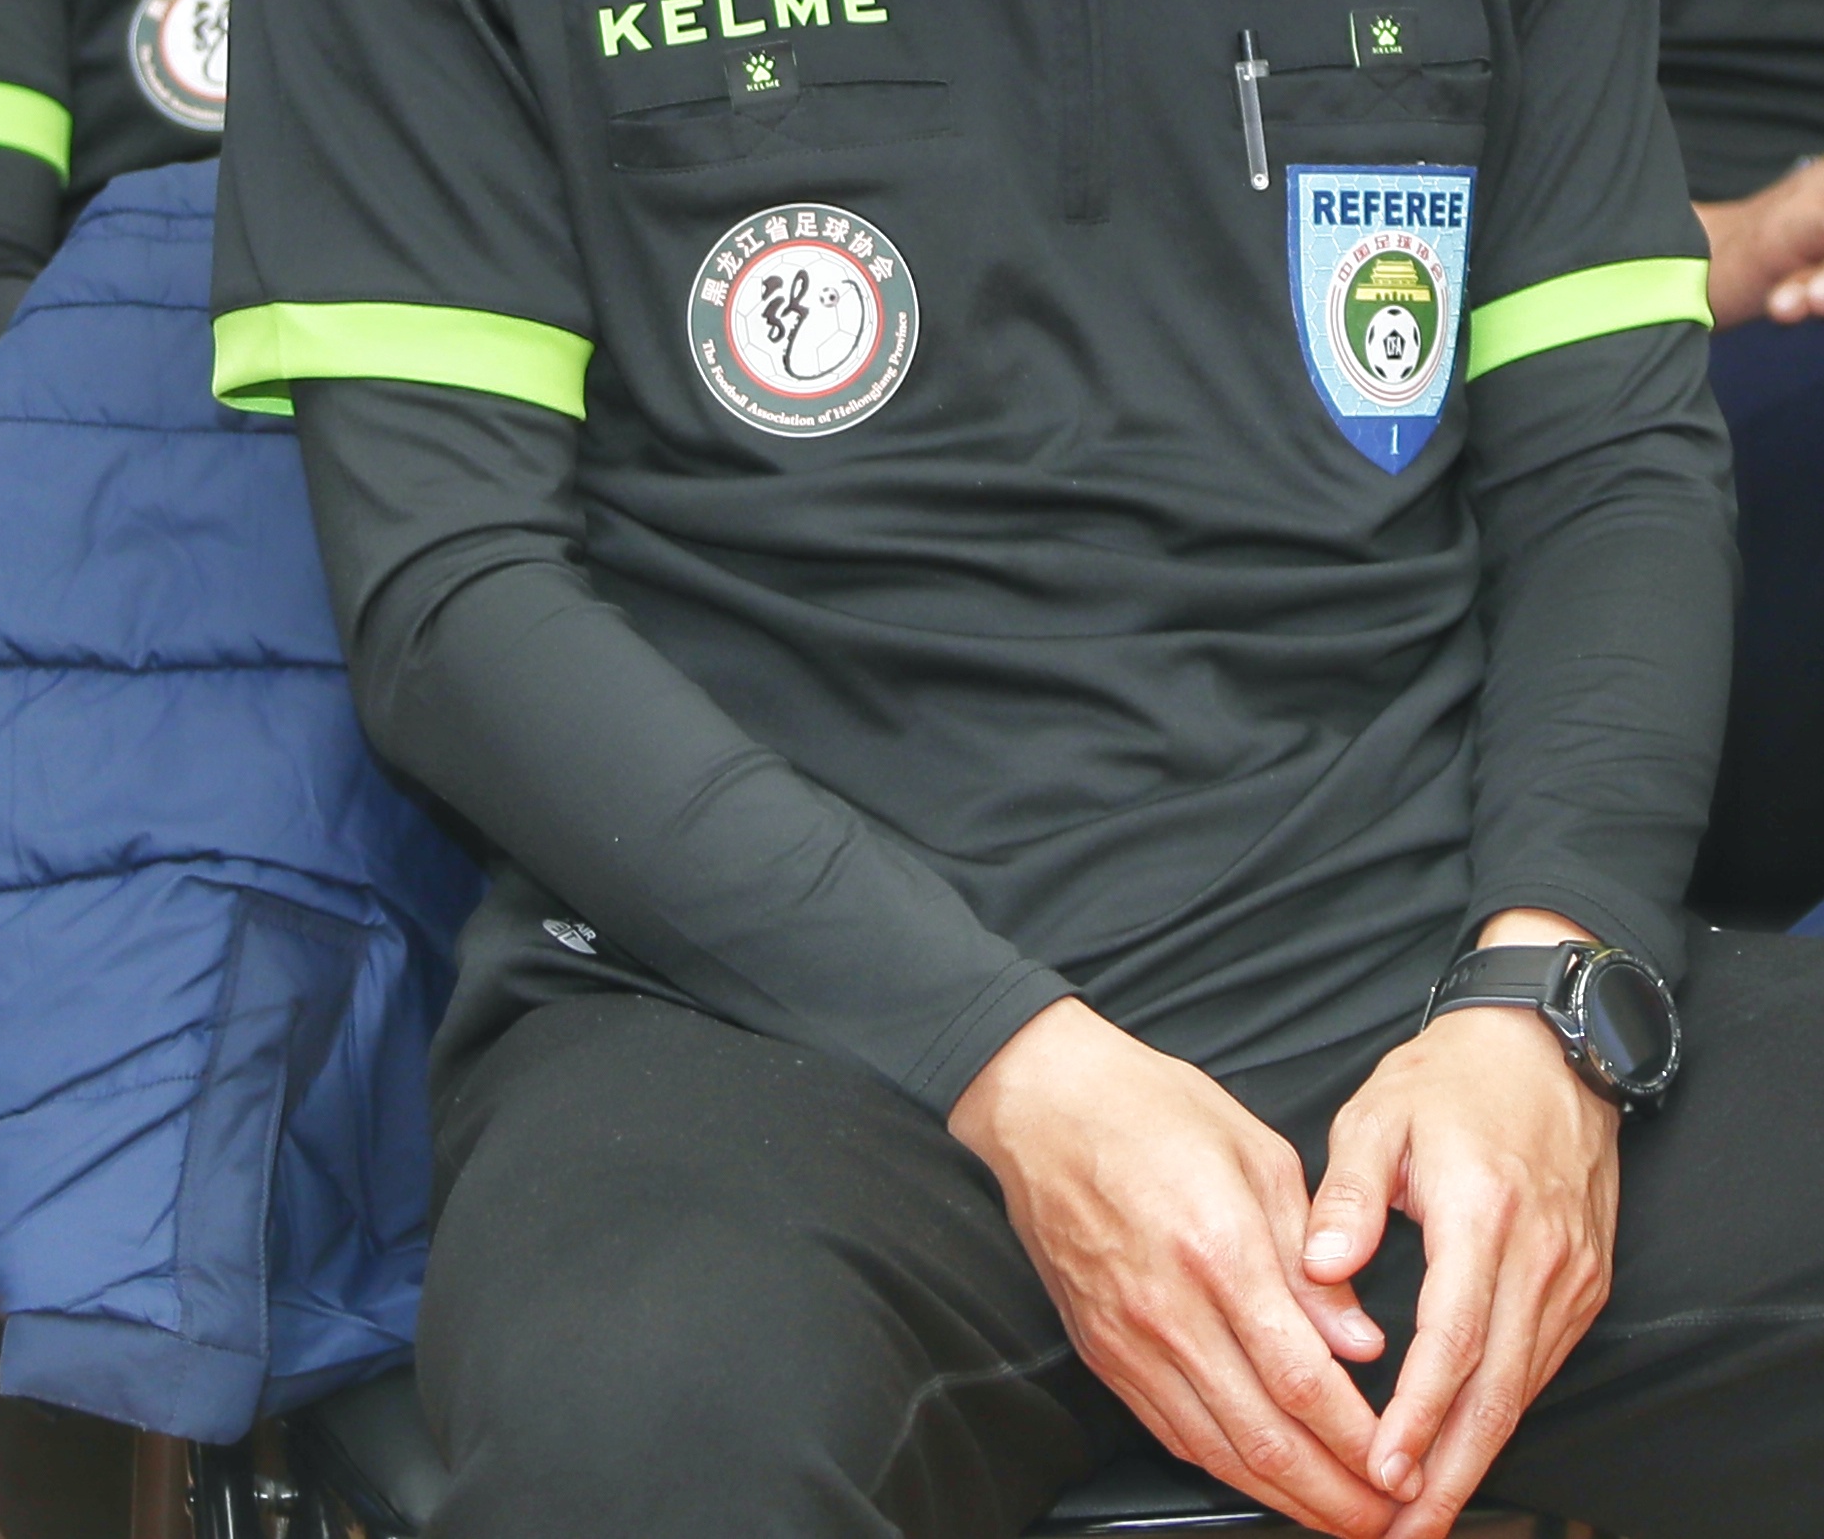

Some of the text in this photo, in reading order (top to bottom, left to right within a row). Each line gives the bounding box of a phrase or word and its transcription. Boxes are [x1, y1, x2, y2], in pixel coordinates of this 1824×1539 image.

[746, 78, 781, 92] KELME
[1312, 190, 1464, 228] REFEREE
[701, 212, 894, 308] 黑龙江省足球协会
[702, 338, 715, 365] The
[712, 366, 749, 413] Football
[747, 398, 816, 426] Association
[817, 410, 835, 425] of
[888, 310, 908, 367] Province
